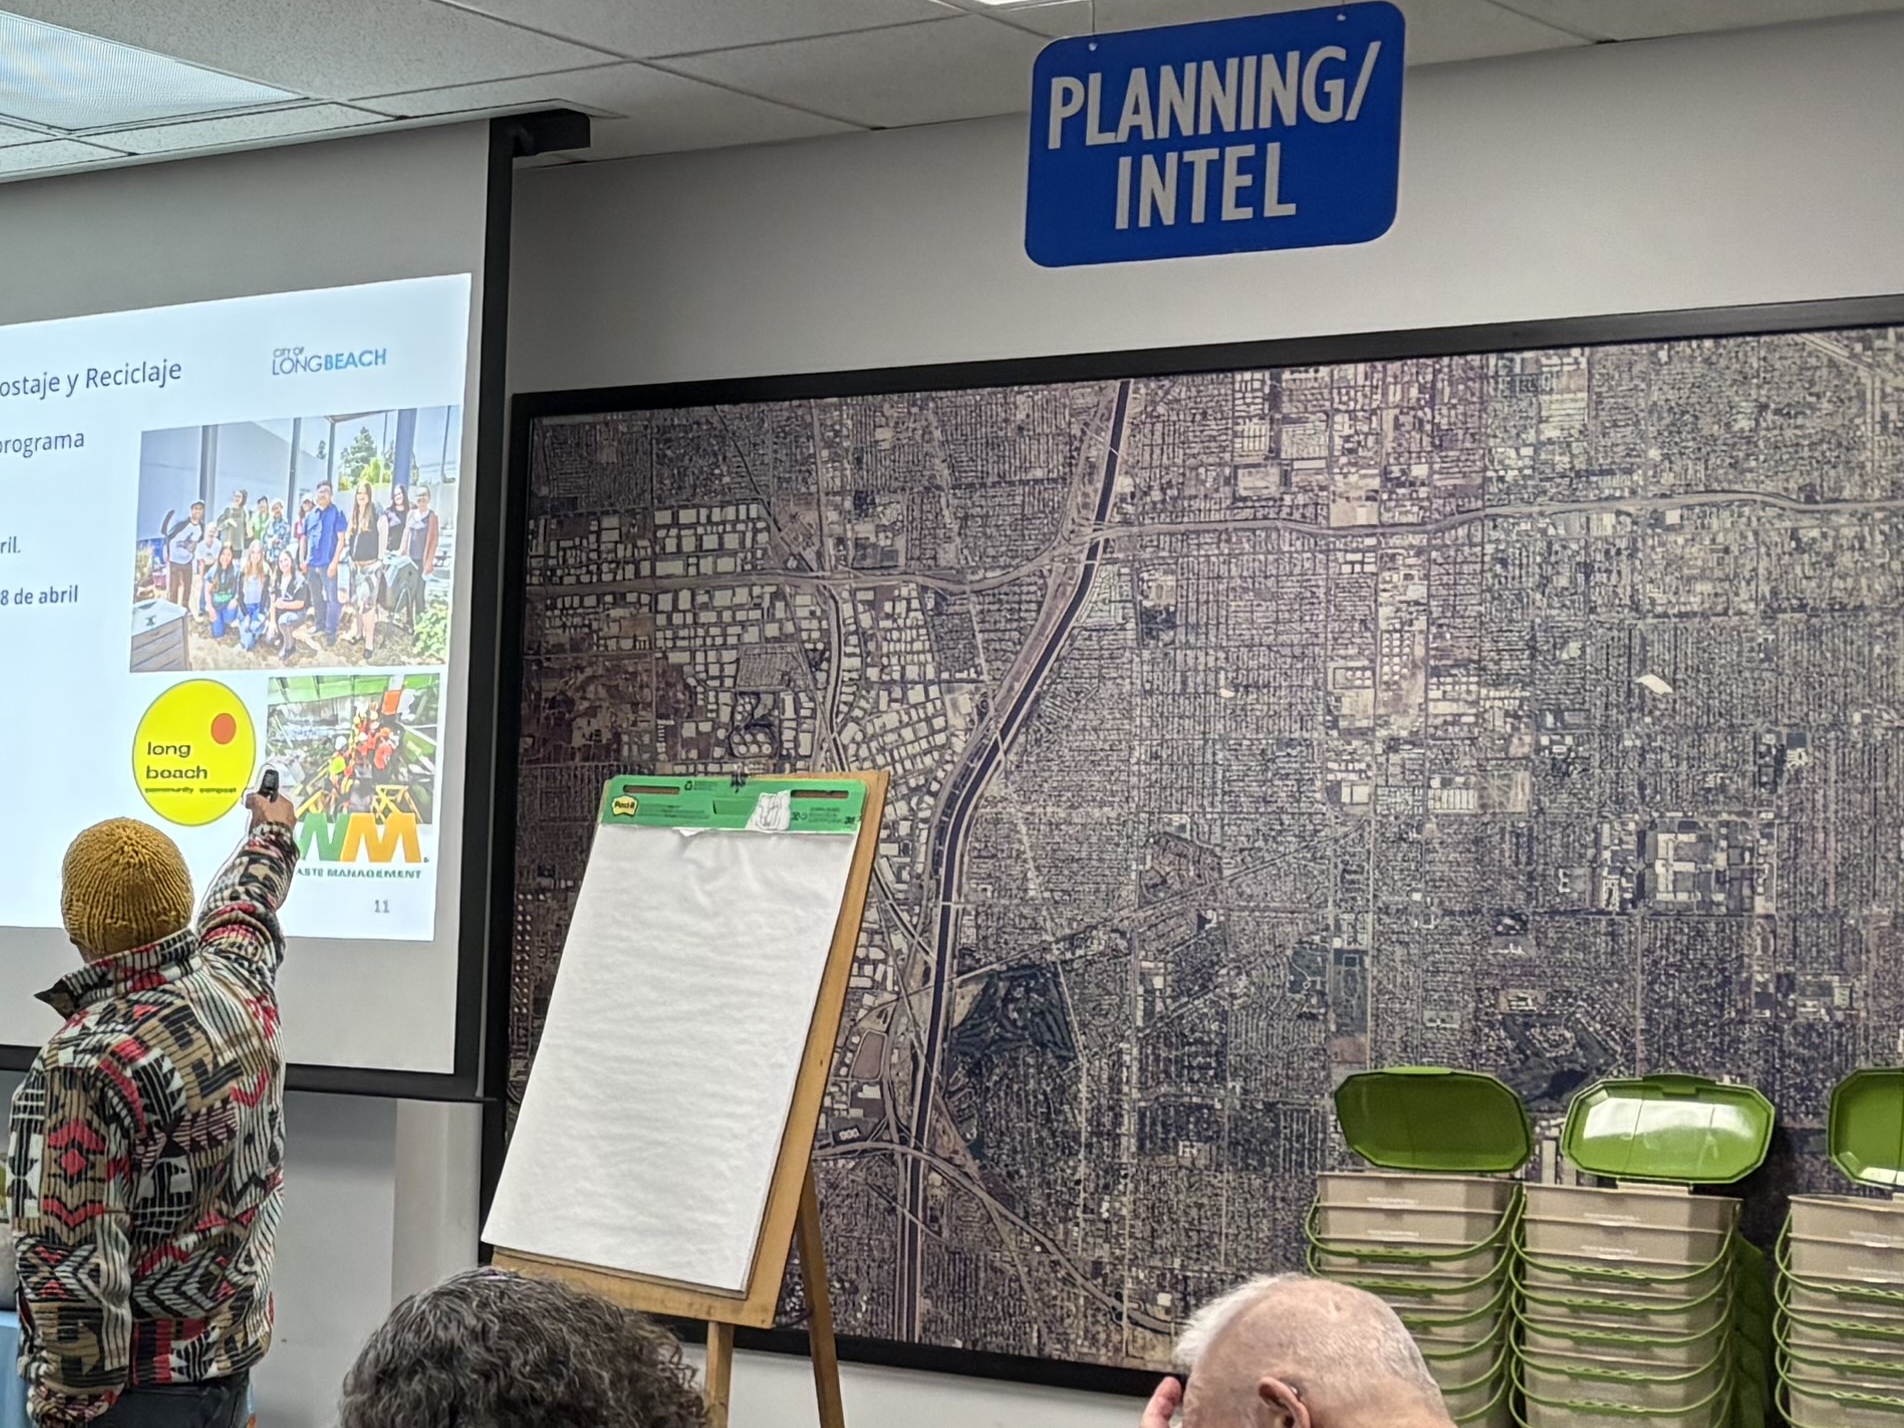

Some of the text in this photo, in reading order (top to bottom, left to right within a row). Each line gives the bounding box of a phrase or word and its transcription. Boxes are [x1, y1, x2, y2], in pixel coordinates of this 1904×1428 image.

[1047, 40, 1382, 150] PLANNING/
[1114, 141, 1297, 230] INTEL
[65, 372, 80, 398] y
[85, 358, 182, 389] Reciclaje
[14, 587, 34, 606] de
[38, 584, 79, 604] abril
[147, 741, 192, 759] long
[297, 867, 324, 878] ASTE
[374, 899, 390, 914] 11
